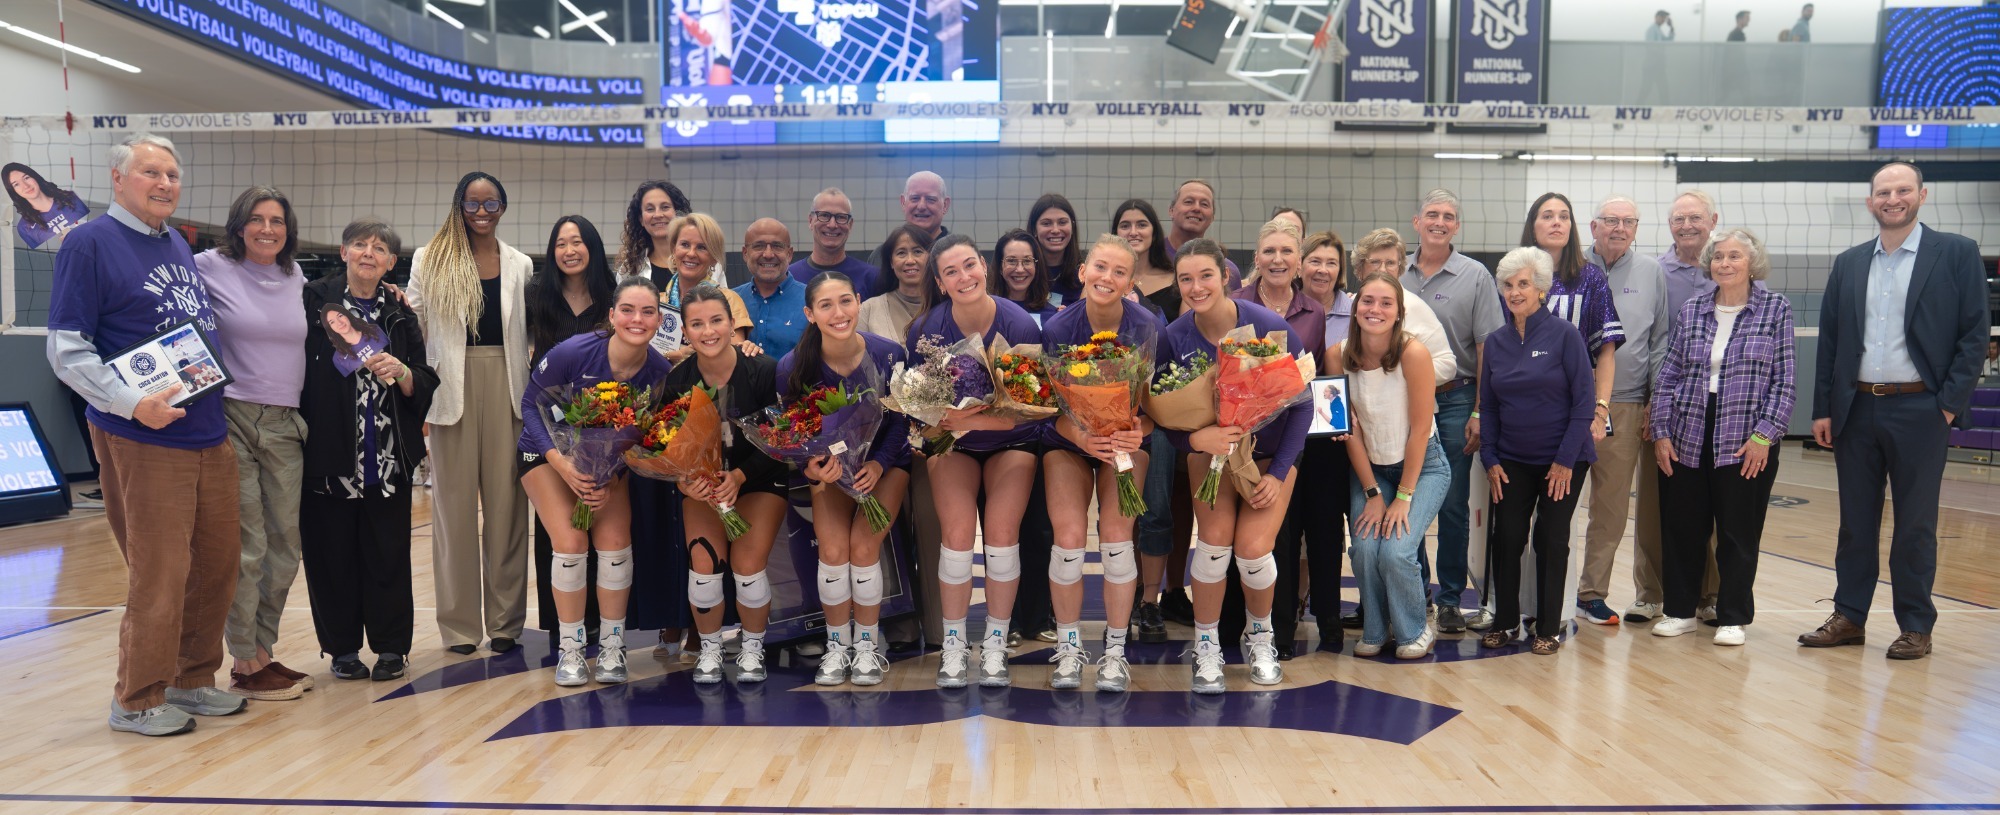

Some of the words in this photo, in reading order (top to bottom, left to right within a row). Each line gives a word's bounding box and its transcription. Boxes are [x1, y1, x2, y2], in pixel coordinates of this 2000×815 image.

[323, 6, 391, 54] VOLLEYBALL
[391, 40, 472, 81] VOLLEYBALL
[477, 68, 592, 94] VOLLEYBALL
[598, 80, 643, 95] VOLL
[296, 24, 367, 72] VOLLEYBALL
[369, 59, 438, 99] VOLLEYBALL
[1360, 56, 1411, 68] NATIONAL
[1473, 58, 1524, 70] NATIONAL
[242, 31, 324, 82] VOLLEYBALL
[325, 68, 392, 110] VOLLEYBALL
[1351, 69, 1419, 83] RUNNERS-UP
[1464, 72, 1532, 84] RUNNERS-UP
[801, 85, 859, 104] 1:15
[93, 116, 127, 128] NYU
[149, 113, 252, 127] #GOVIOLETS
[273, 113, 307, 125] NYU
[332, 112, 432, 125] VOLLEYBALL
[456, 110, 491, 123] NYU
[515, 107, 621, 122] #GOVIOLETS
[644, 107, 679, 119] NYU
[706, 105, 811, 118] VOLLEYBALL
[836, 104, 873, 116] NYU
[897, 102, 1008, 117] #GOVIOLETS
[1032, 102, 1069, 115] NYU
[1096, 102, 1202, 116] VOLLEYBALL
[1228, 103, 1265, 116] NYU
[1290, 103, 1400, 117] #GOVIOLETS
[1424, 105, 1460, 117] NYU
[1486, 105, 1591, 119] VOLLEYBALL
[1615, 107, 1652, 120] NYU
[1675, 107, 1785, 121] #GOVIOLETS
[1806, 108, 1844, 121] NYU
[1870, 108, 1975, 121] VOLLEYBALL
[47, 214, 65, 229] NYU
[143, 264, 173, 296] NEW
[356, 344, 371, 358] NYU
